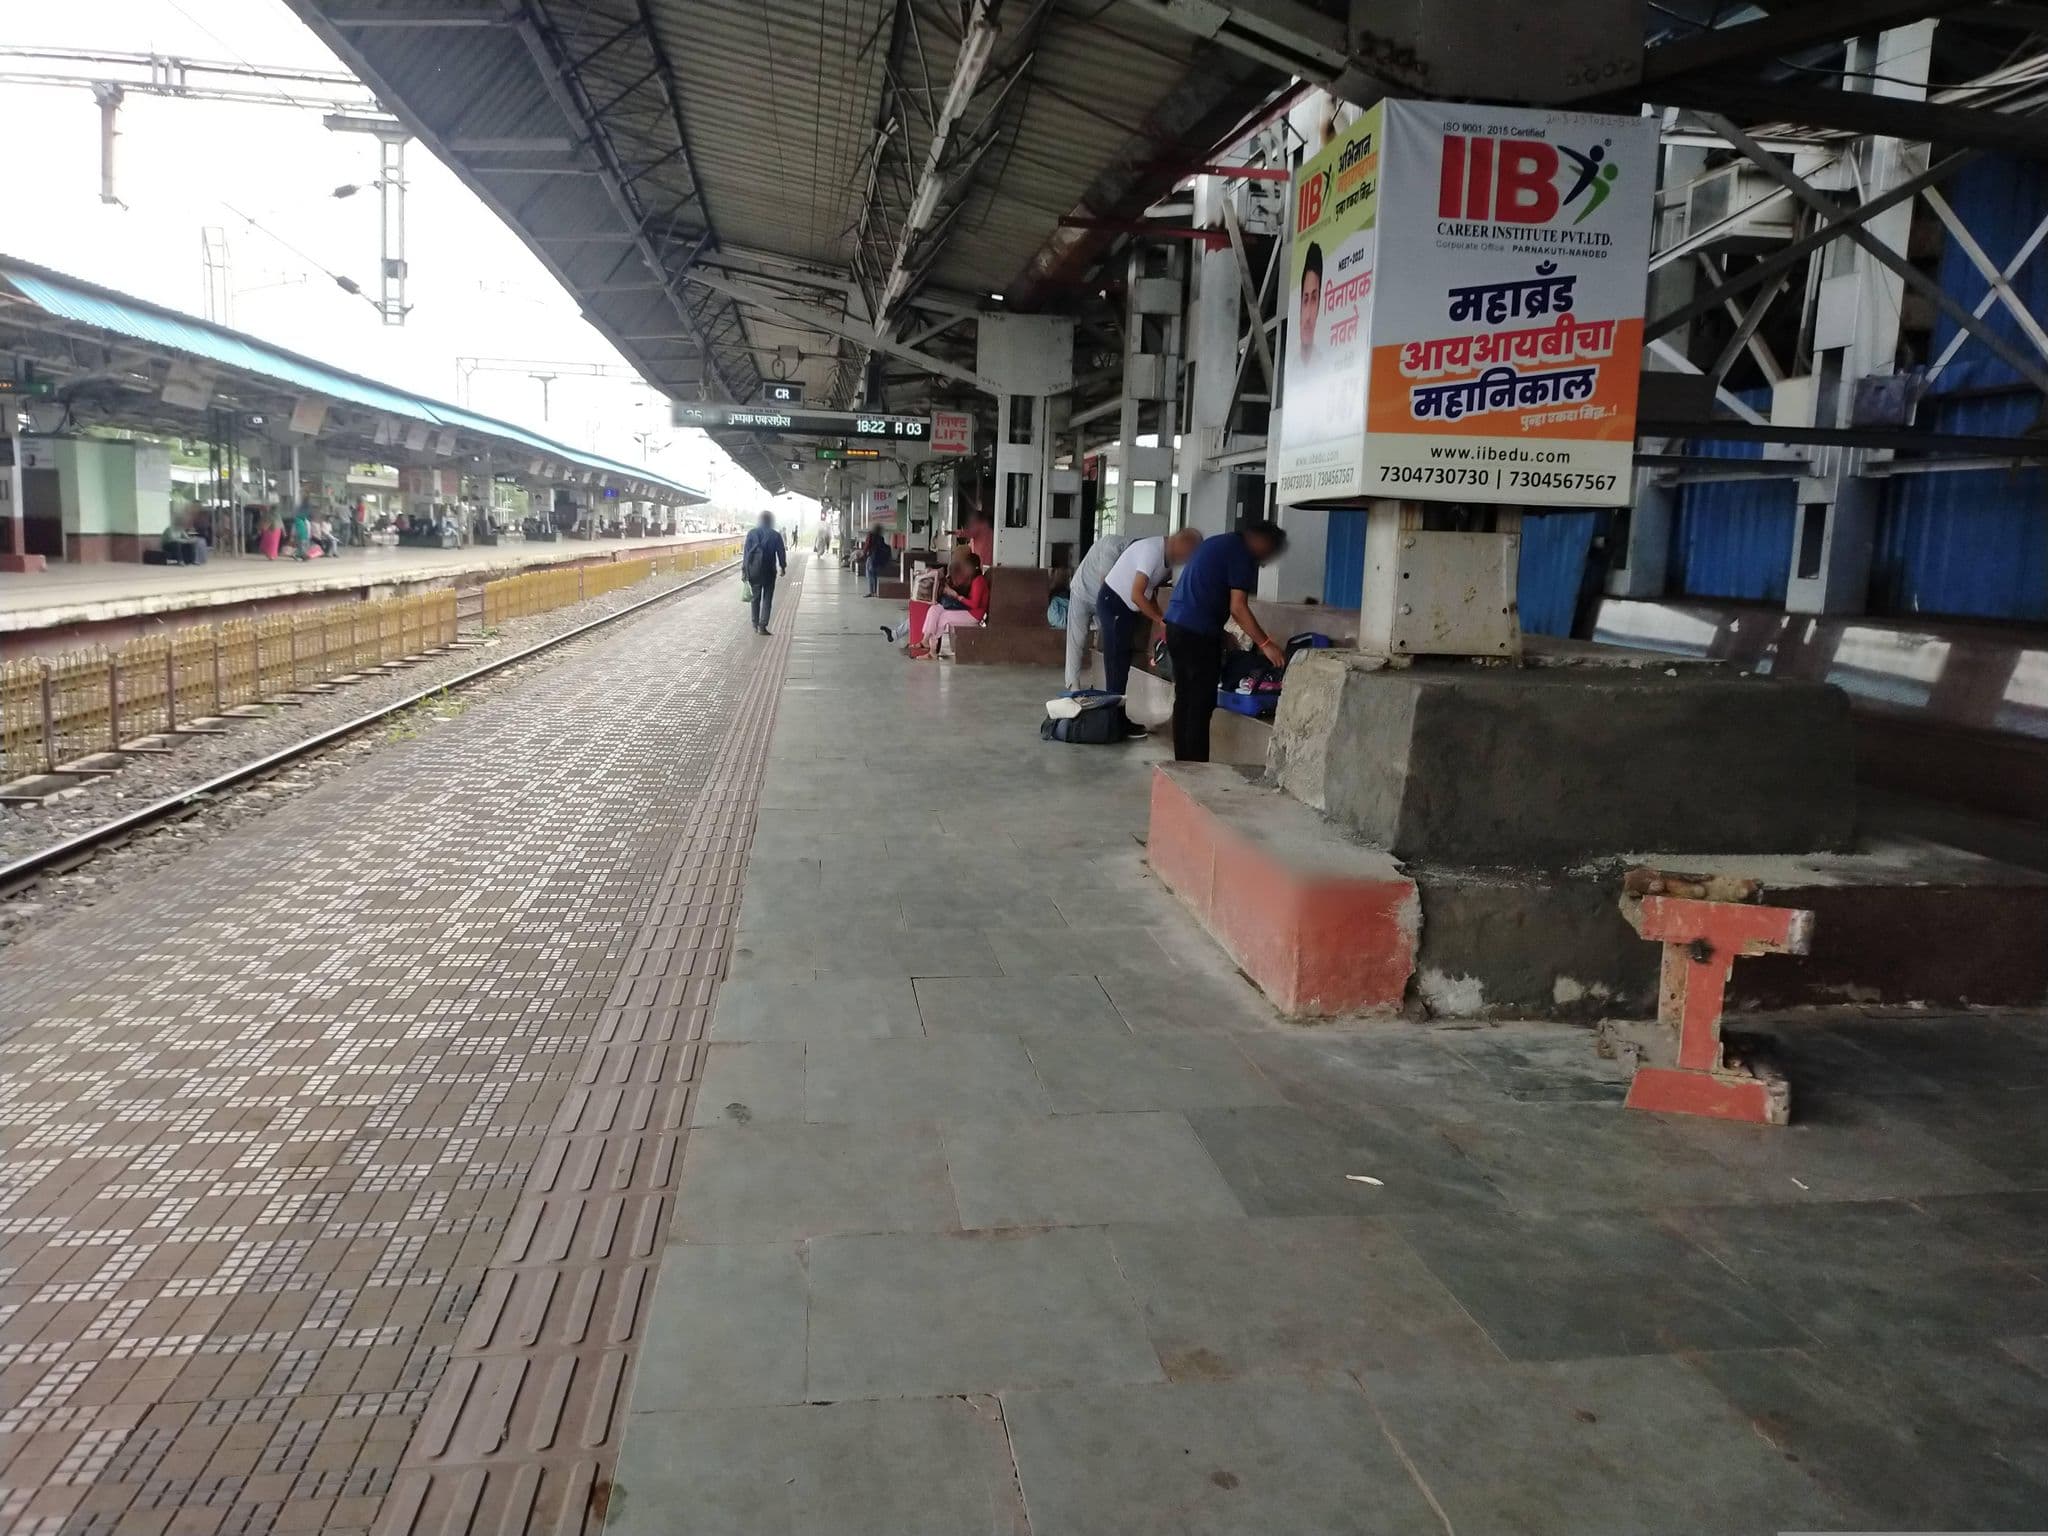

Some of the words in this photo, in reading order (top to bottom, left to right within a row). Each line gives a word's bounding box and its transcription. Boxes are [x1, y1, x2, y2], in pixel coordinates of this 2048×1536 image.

[1443, 121, 1460, 132] ISO
[1487, 124, 1508, 136] 2015
[1510, 126, 1546, 138] Certified
[1339, 132, 1372, 173] अभिमान
[1438, 134, 1560, 224] IIB
[1297, 171, 1323, 234] IIB
[1437, 222, 1489, 239] CAREER
[1492, 226, 1558, 243] INSTITUTE
[1561, 231, 1613, 247] PVT.LTD.
[1436, 240, 1479, 251] Corporate
[1512, 244, 1608, 259] PARNAKUTI-NANDED
[1324, 268, 1373, 316] विनायक
[1448, 260, 1577, 325] महाब्रँड
[1330, 304, 1360, 347] नवले
[1402, 311, 1617, 374] आयआयबीचा
[775, 388, 790, 399] CR
[1412, 365, 1597, 420] महानिकाल
[857, 420, 886, 433] 18:22
[906, 423, 922, 435] 03
[935, 428, 968, 440] LIFT
[1430, 445, 1571, 464] www.iibedu.com
[1317, 467, 1355, 487] 7304567567
[1379, 466, 1489, 486] 7304730730
[1509, 471, 1617, 491] 7304567567
